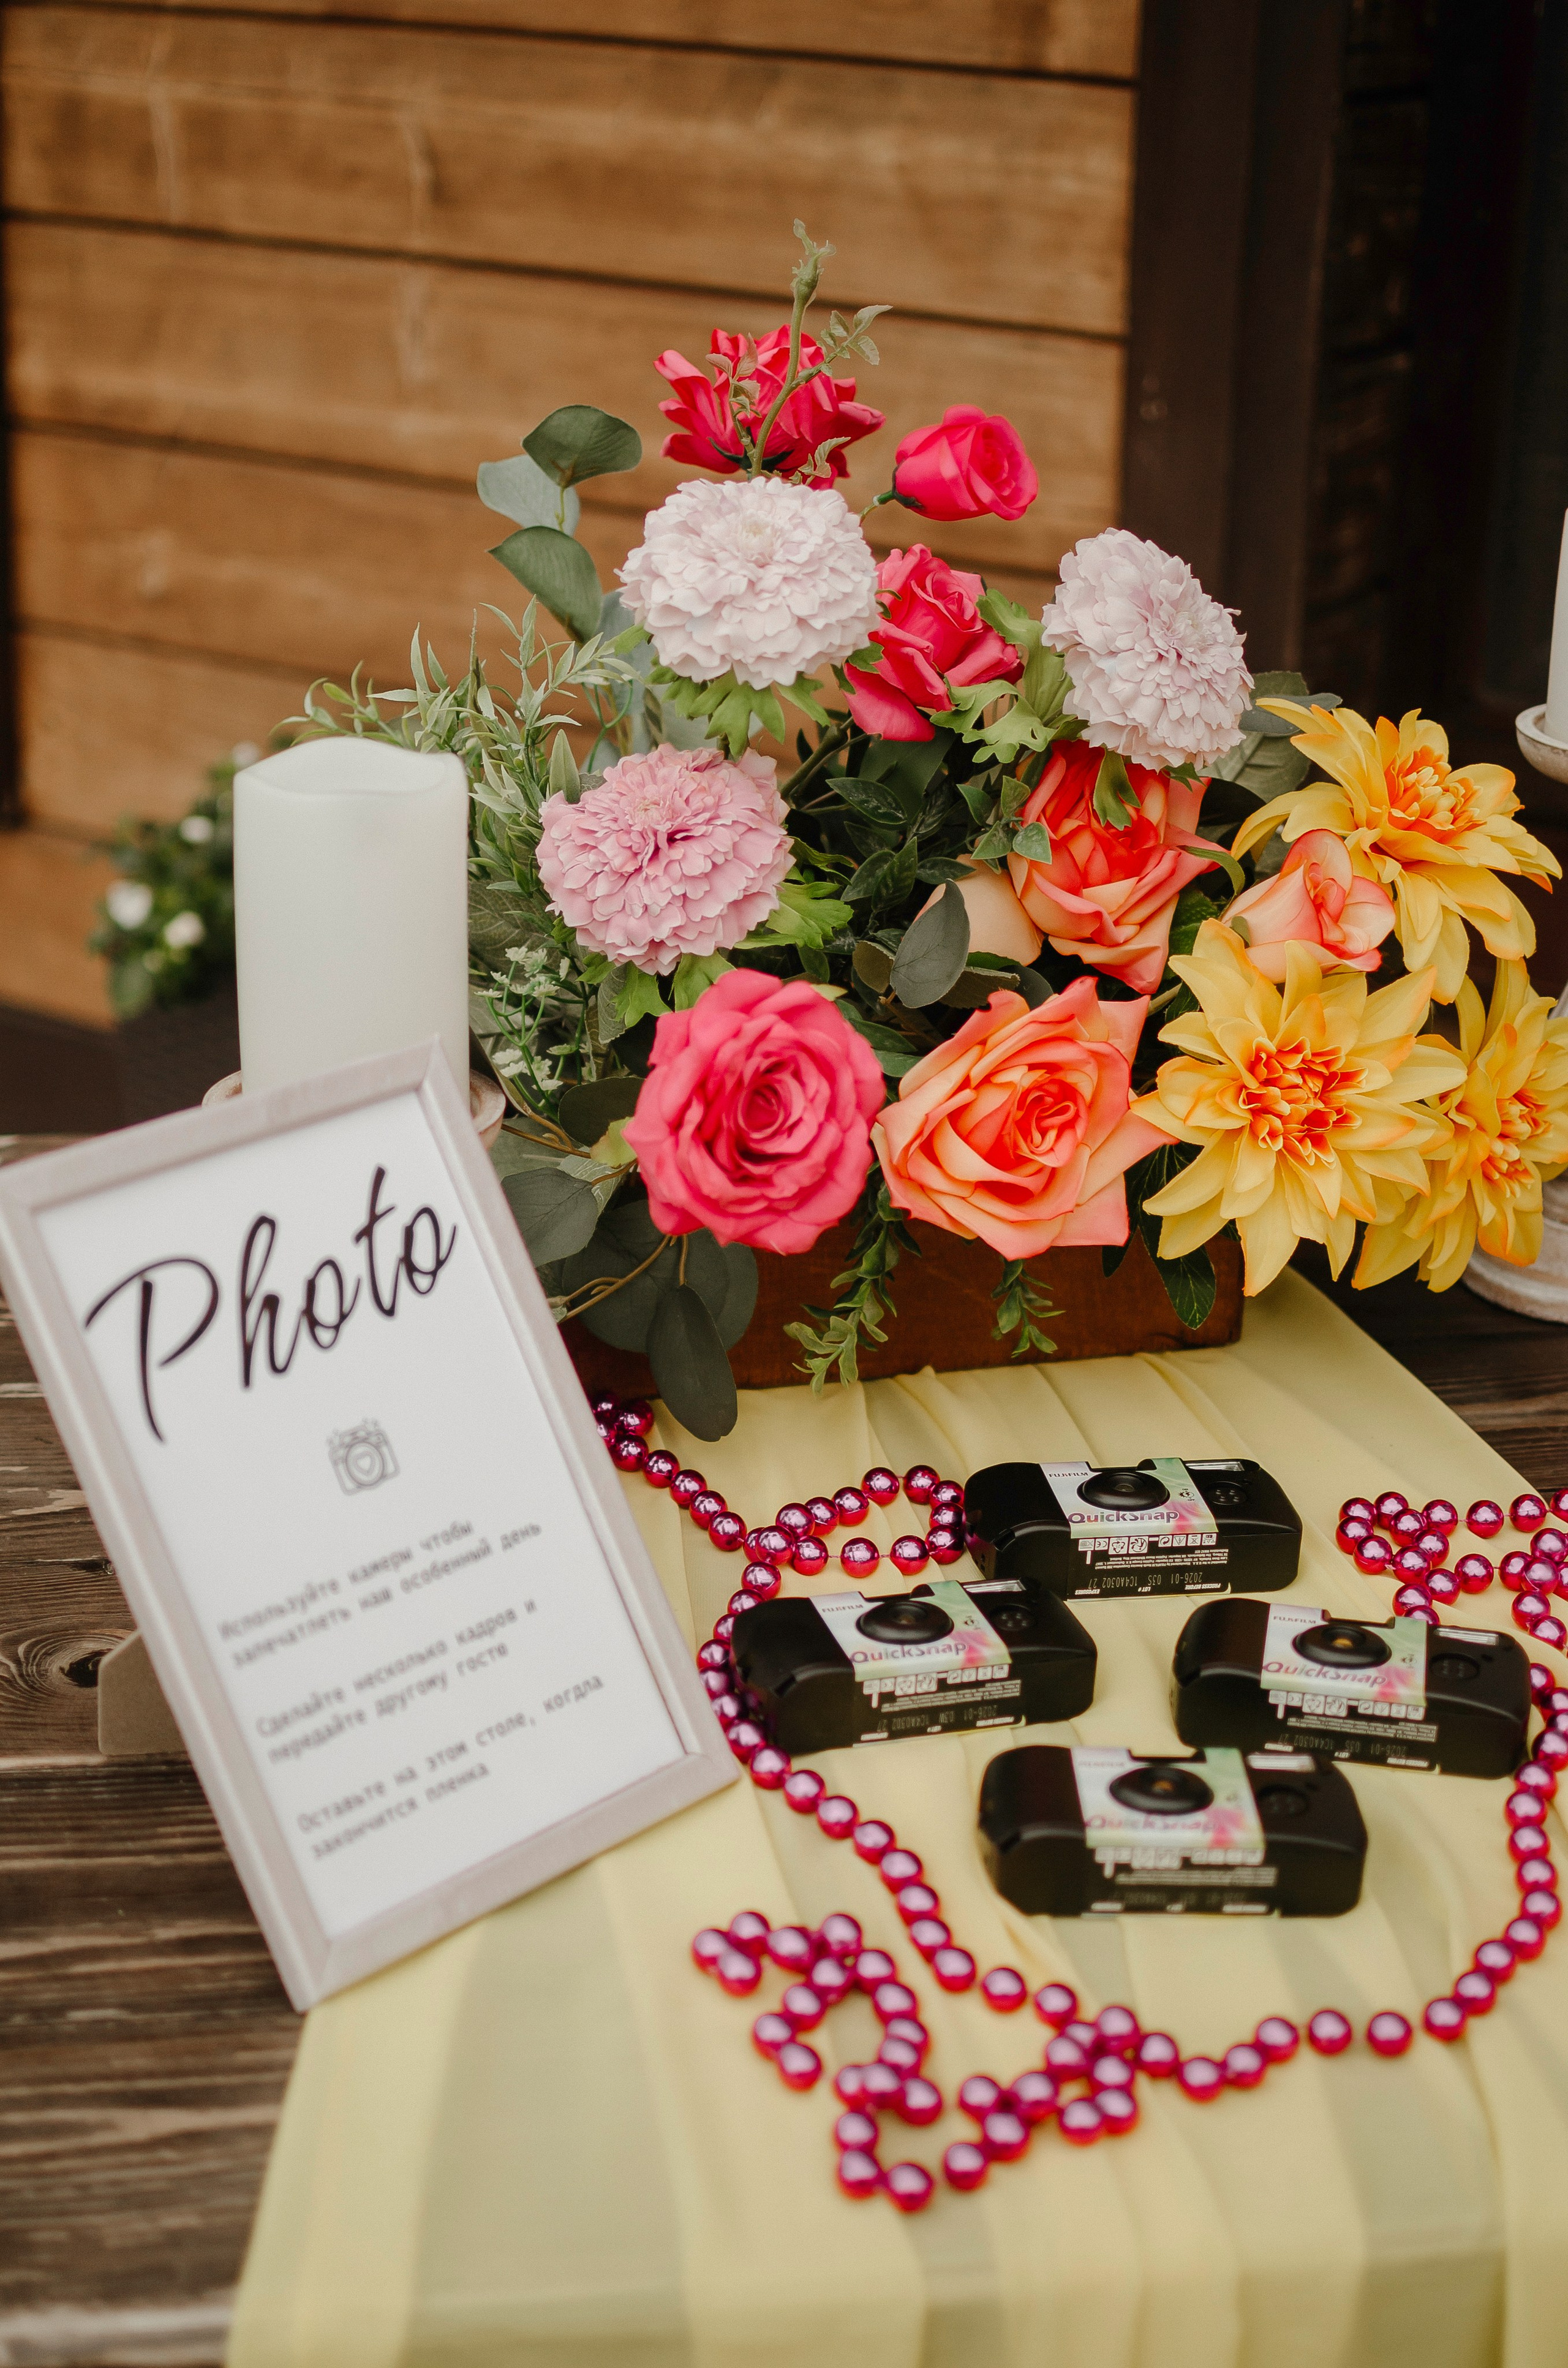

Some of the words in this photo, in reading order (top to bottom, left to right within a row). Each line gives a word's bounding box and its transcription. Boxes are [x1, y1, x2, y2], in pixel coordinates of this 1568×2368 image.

[84, 1165, 458, 1445] Photo
[1068, 1511, 1178, 1524] QuickSnap
[347, 1546, 413, 1584] камеры
[420, 1520, 473, 1551] чтобы
[358, 1587, 392, 1611] наш
[399, 1537, 492, 1594] особенный
[500, 1523, 541, 1552] день
[1088, 1578, 1098, 1589] 27
[1102, 1576, 1137, 1588] 1C4A0302
[1170, 1572, 1202, 1583] 2026-01
[353, 1640, 448, 1692] несколько
[455, 1607, 518, 1646] кадров
[524, 1598, 537, 1614] и
[850, 1642, 967, 1663] QuickSnap
[374, 1670, 448, 1717] другому
[1262, 1662, 1387, 1687] QuickSnap
[394, 1766, 418, 1787] на
[425, 1741, 469, 1772] этом
[475, 1712, 537, 1747] столе,
[424, 1763, 489, 1802] пленка
